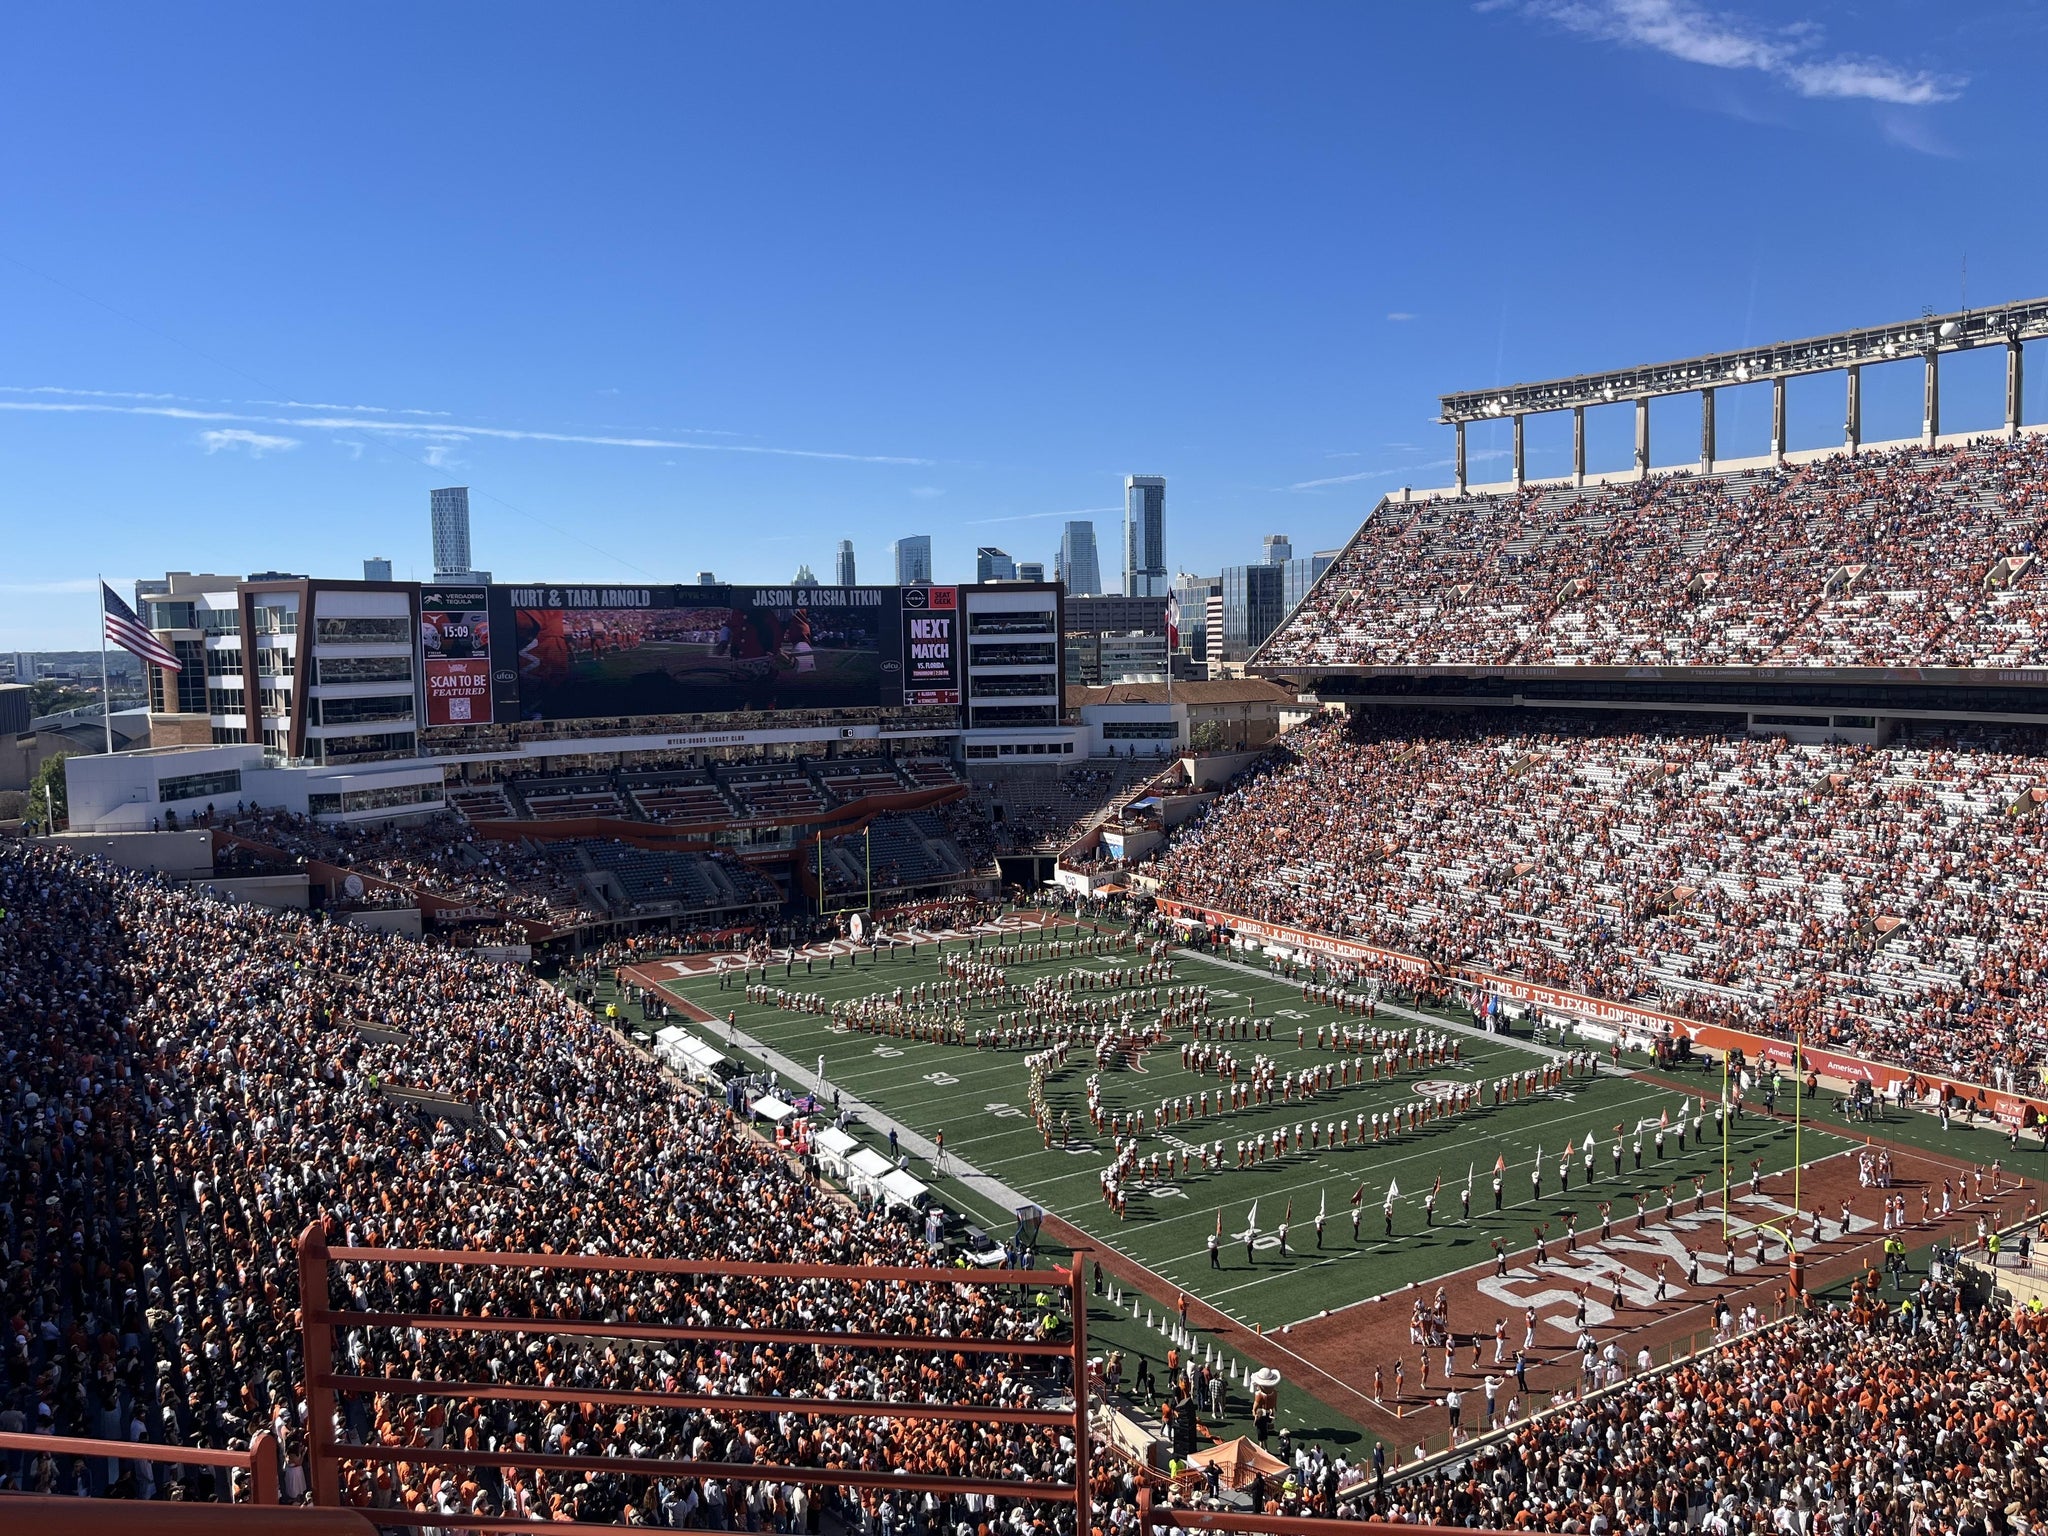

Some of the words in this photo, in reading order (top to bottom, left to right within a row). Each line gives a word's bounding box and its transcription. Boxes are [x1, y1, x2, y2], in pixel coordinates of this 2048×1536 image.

[510, 589, 544, 607] KURT
[548, 589, 562, 607] &
[566, 589, 598, 607] TARA
[600, 589, 650, 607] ARNOLD
[752, 590, 792, 606] JASON
[797, 590, 809, 606] &
[811, 590, 847, 606] KISHA
[850, 590, 882, 606] ITKIN
[443, 626, 469, 638] 15:09
[911, 619, 950, 638] NEXT
[911, 643, 950, 659] MATCH
[430, 675, 457, 688] SCAN
[459, 675, 472, 687] TO
[473, 674, 487, 687] BE
[433, 687, 485, 697] FEATURED
[437, 907, 482, 918] TEXAS
[1238, 920, 1272, 937] DARRELL
[1383, 955, 1426, 975] TDIUM
[1484, 977, 1513, 996] OME
[1515, 985, 1530, 999] OF
[1532, 989, 1556, 1006] THE
[1558, 994, 1598, 1016] TEXAS
[1600, 1004, 1675, 1034] LONGHORNS
[872, 1045, 905, 1058] 40
[1768, 1047, 1793, 1060] Americ
[1827, 1061, 1863, 1075] American
[922, 1071, 960, 1086] 50
[984, 1102, 1022, 1118] 40
[1996, 1112, 2022, 1125] TEXAS
[1478, 1193, 1878, 1334] TEXAS
